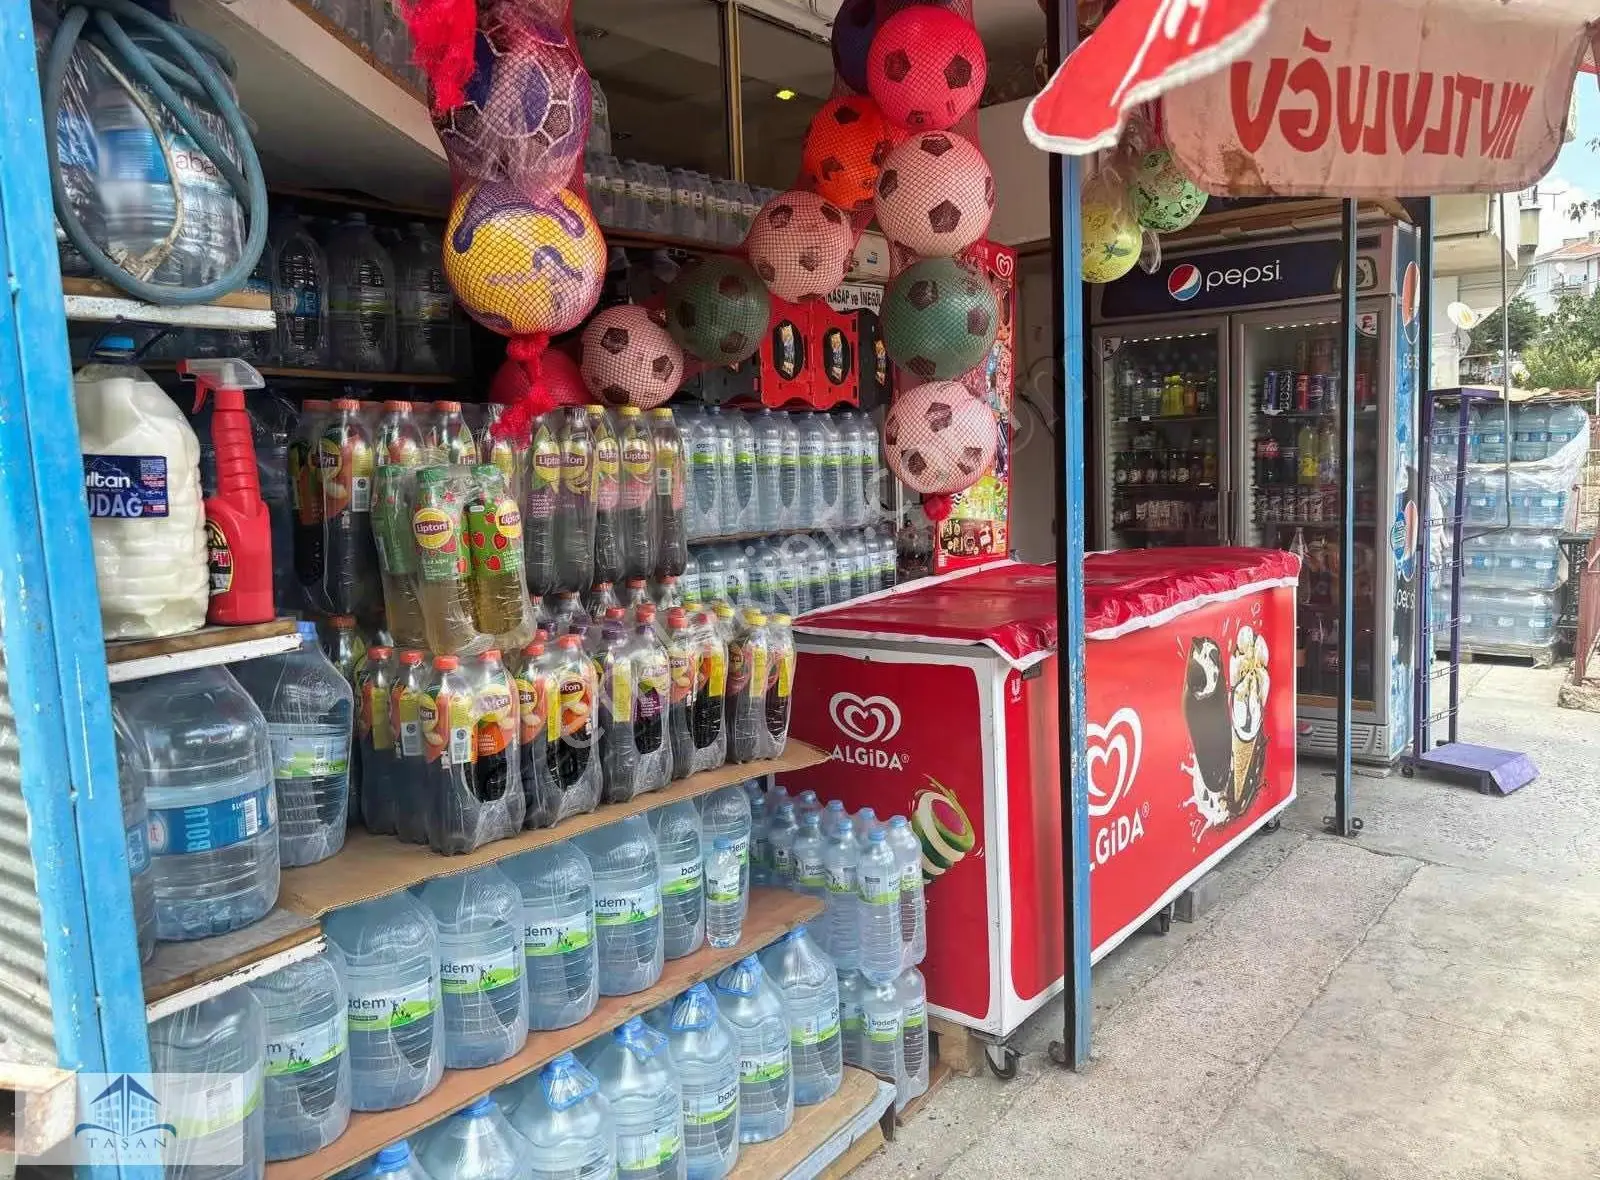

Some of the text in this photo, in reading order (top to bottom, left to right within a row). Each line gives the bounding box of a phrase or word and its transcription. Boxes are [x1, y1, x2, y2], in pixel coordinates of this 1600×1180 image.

[1206, 260, 1281, 292] pepsi
[417, 521, 449, 533] Lipton
[183, 806, 211, 852] BOLU
[525, 926, 552, 937] dem
